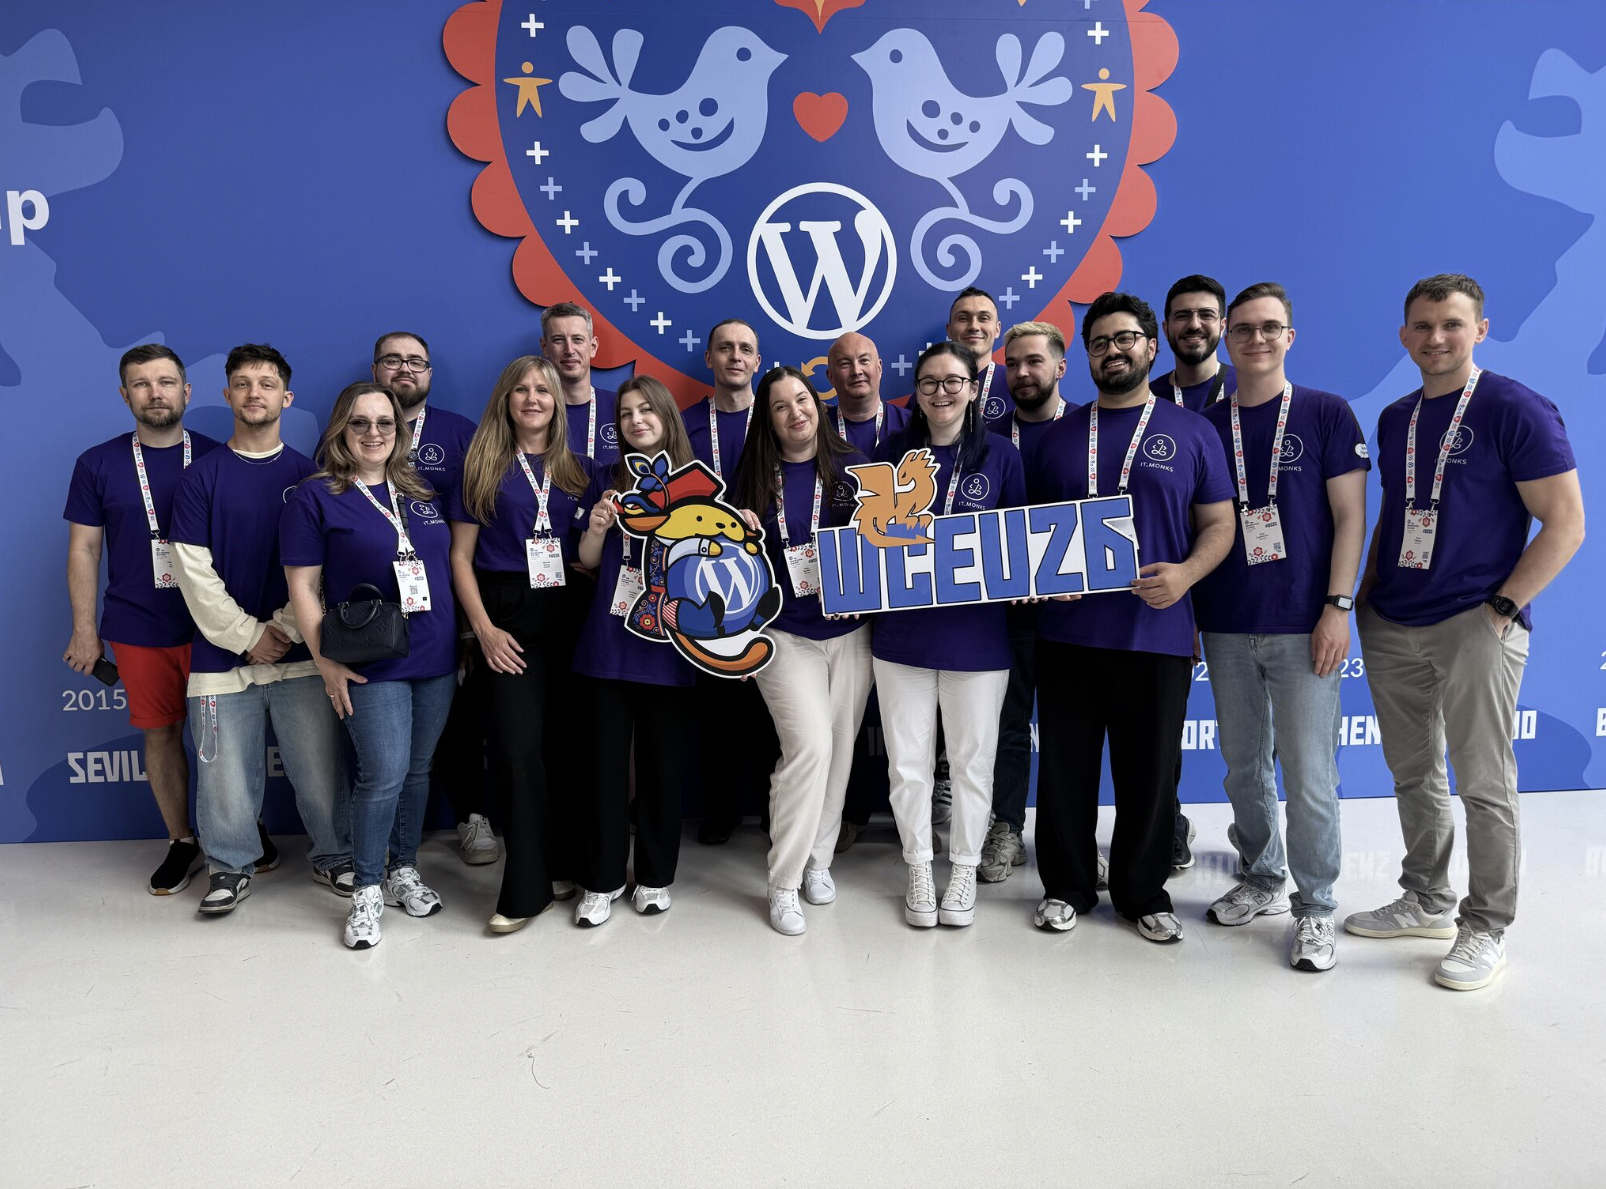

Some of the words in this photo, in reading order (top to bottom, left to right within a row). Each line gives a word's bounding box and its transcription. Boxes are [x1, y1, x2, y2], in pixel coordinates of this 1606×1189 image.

[0, 189, 50, 246] p
[62, 688, 127, 711] 2015
[1181, 720, 1219, 750] OR
